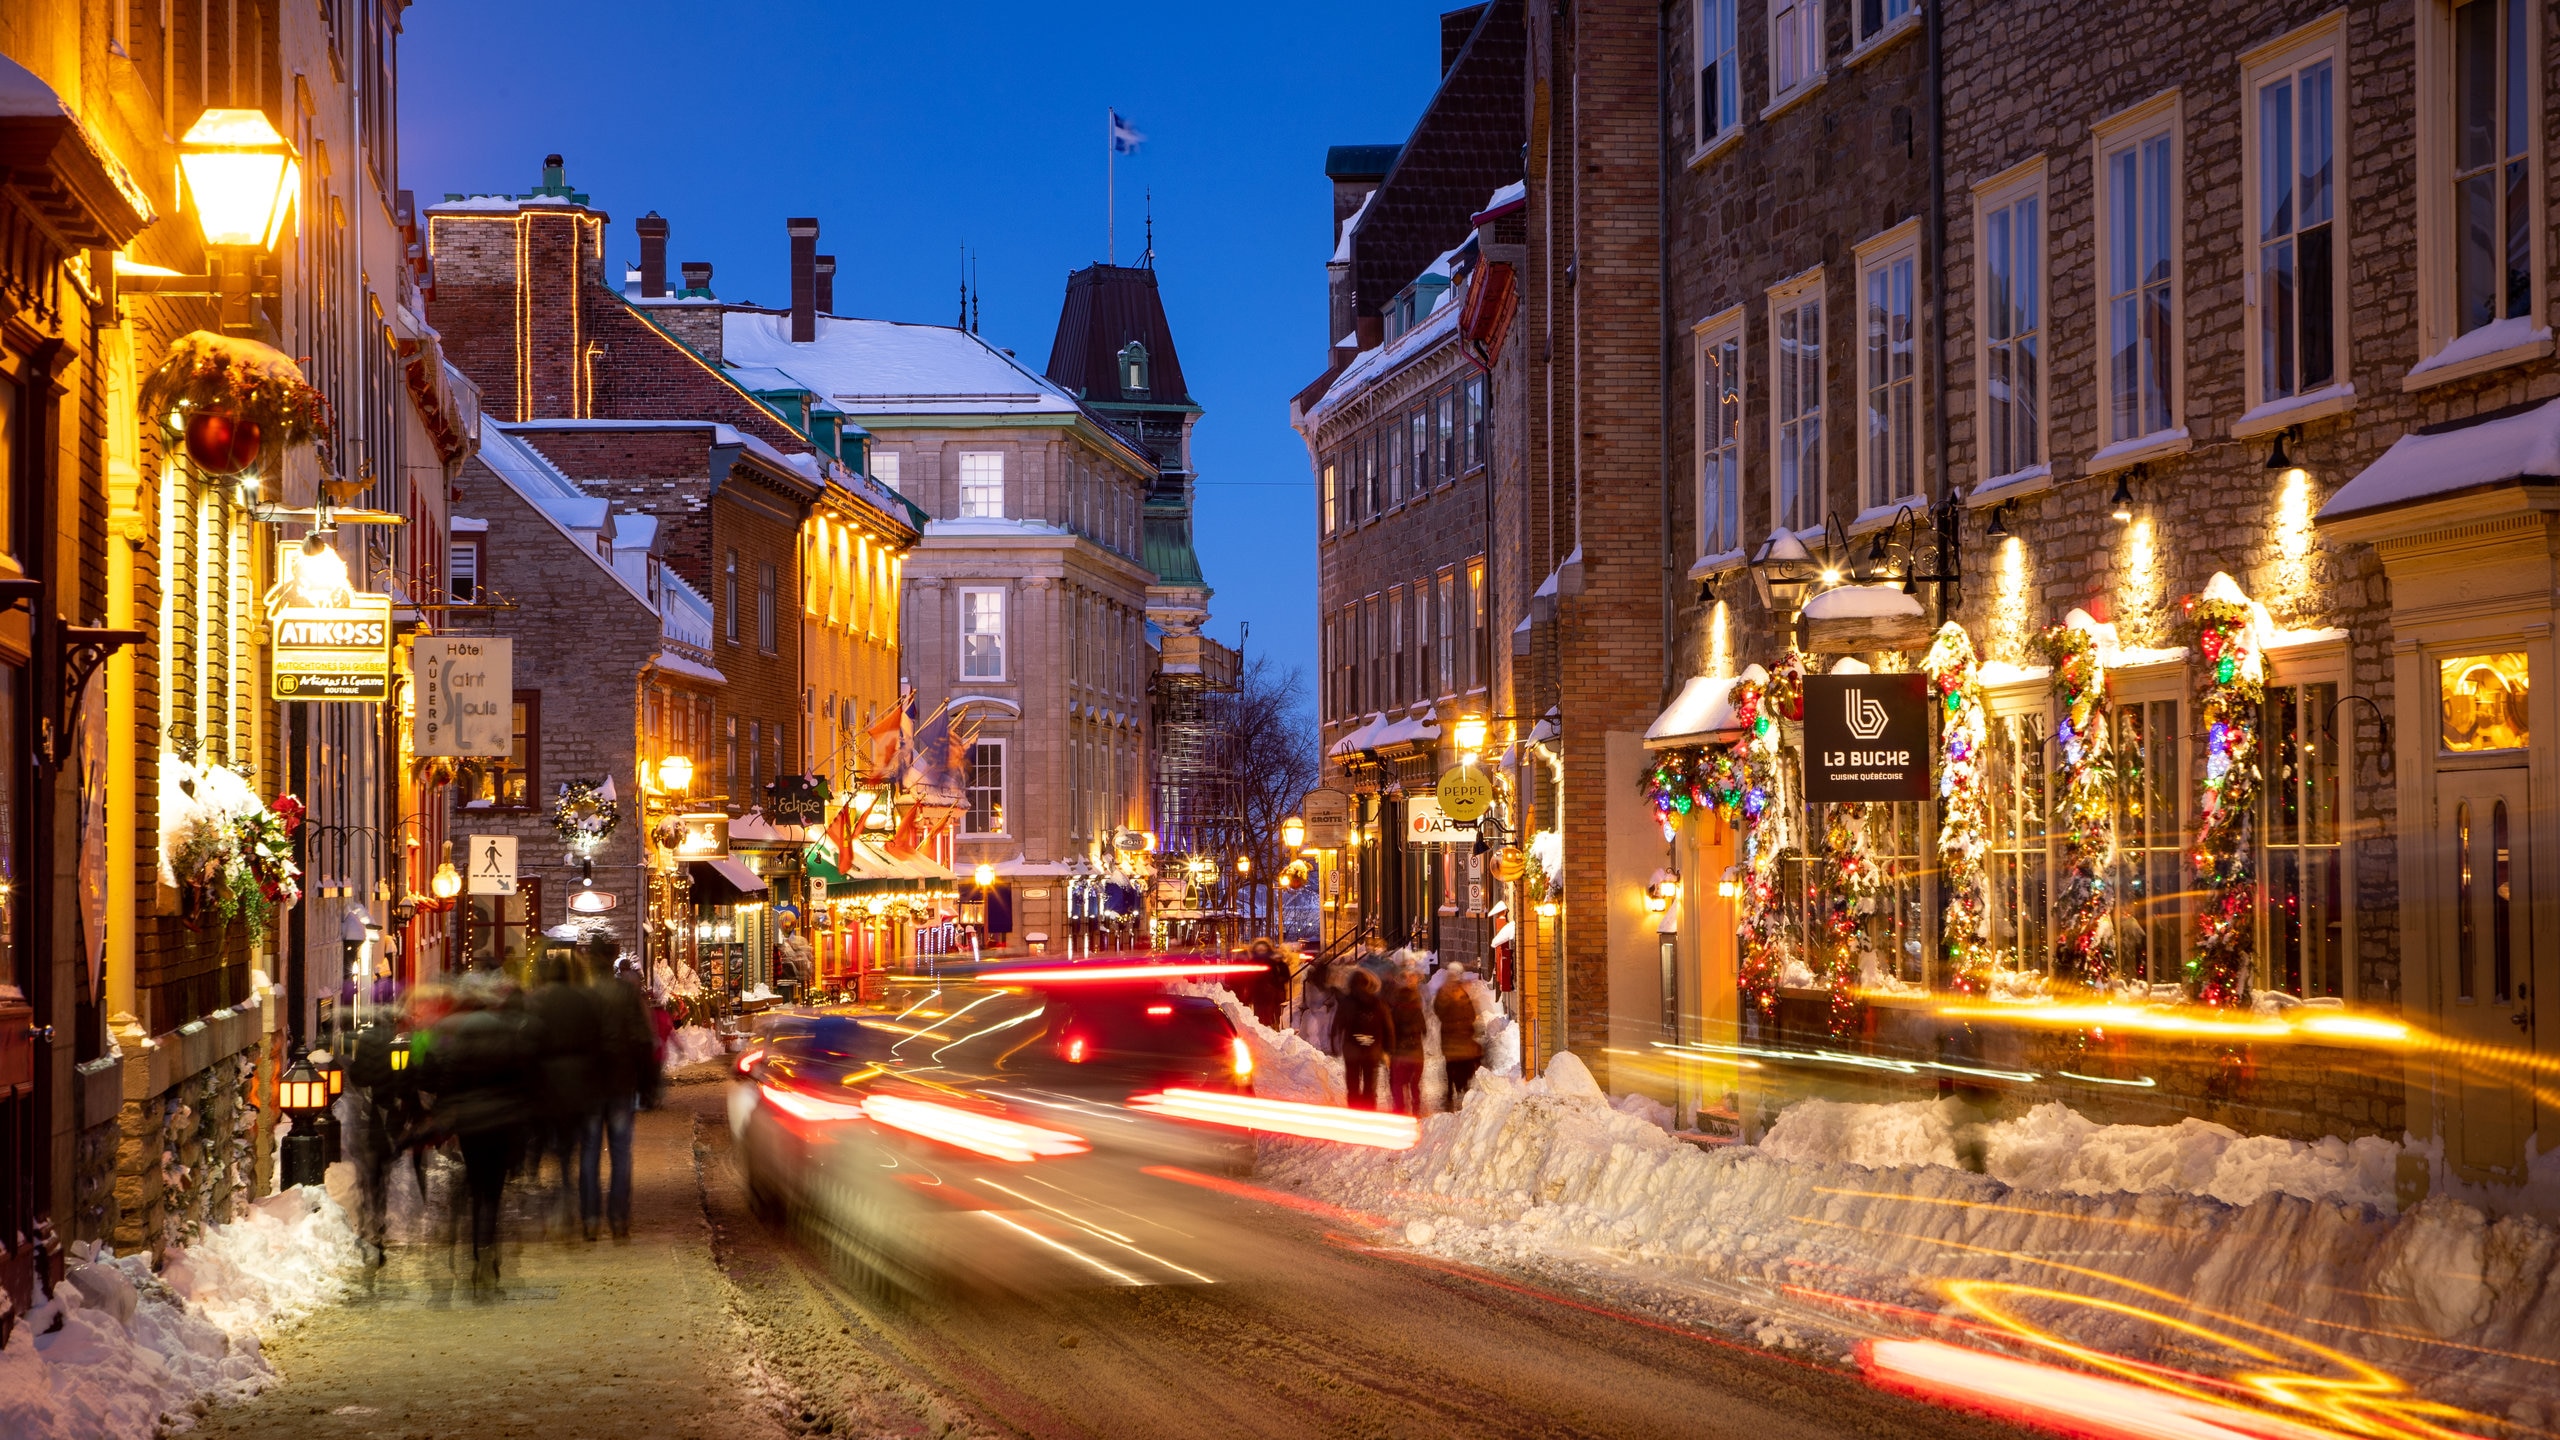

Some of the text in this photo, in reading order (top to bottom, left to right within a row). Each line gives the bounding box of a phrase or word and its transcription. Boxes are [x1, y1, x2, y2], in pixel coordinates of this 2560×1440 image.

[447, 643, 484, 656] Hôtel
[277, 662, 337, 671] AUTOCHTONES
[339, 662, 351, 671] DU
[427, 655, 438, 746] AUBERGE
[441, 660, 486, 725] Saint
[455, 692, 497, 749] Louis
[1830, 771, 1904, 781] CUISINE QUÉBÉCOISE
[1444, 785, 1485, 797] PEPPE
[1413, 812, 1478, 833] JAP
